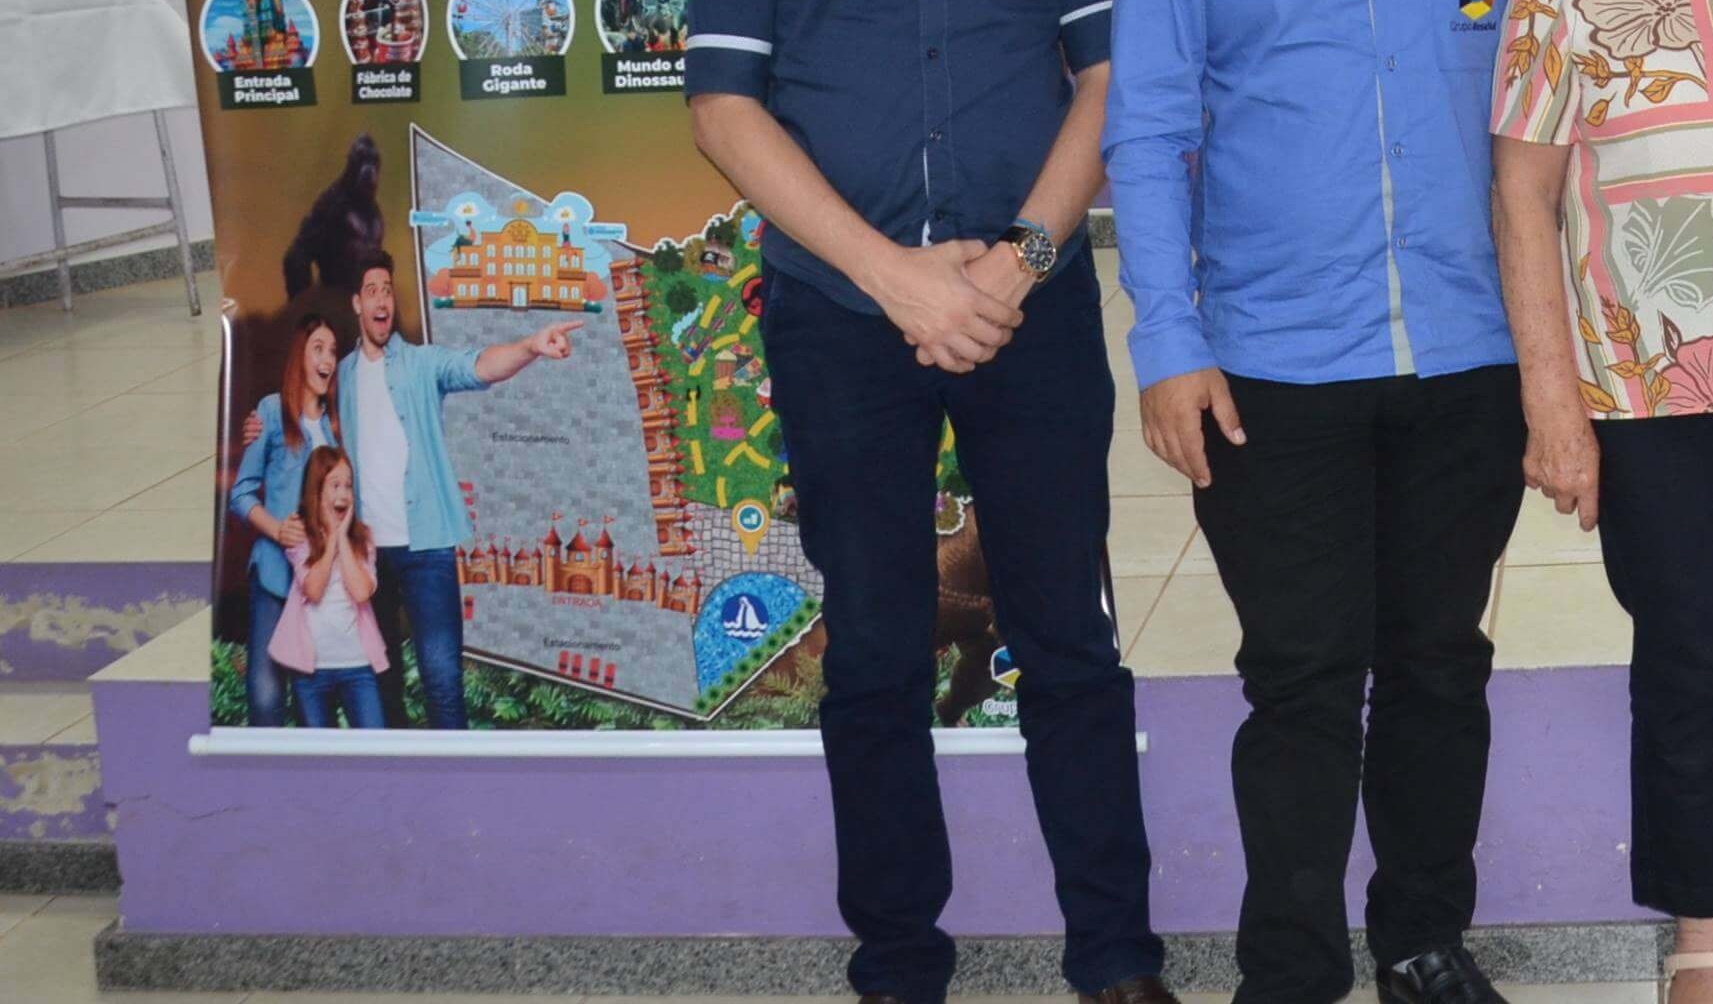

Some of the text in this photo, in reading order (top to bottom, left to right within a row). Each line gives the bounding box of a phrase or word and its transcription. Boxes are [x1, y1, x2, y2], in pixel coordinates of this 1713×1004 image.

[490, 62, 533, 77] Roda
[616, 57, 672, 73] Mundo
[233, 74, 292, 90] Entrada
[356, 70, 412, 85] Fábrica de
[614, 72, 685, 88] Dinossau
[358, 84, 412, 99] Chocolate
[482, 78, 547, 94] Gigante
[233, 88, 299, 104] Principal
[492, 431, 570, 445] Estacionamento
[543, 636, 622, 651] Estacionamento
